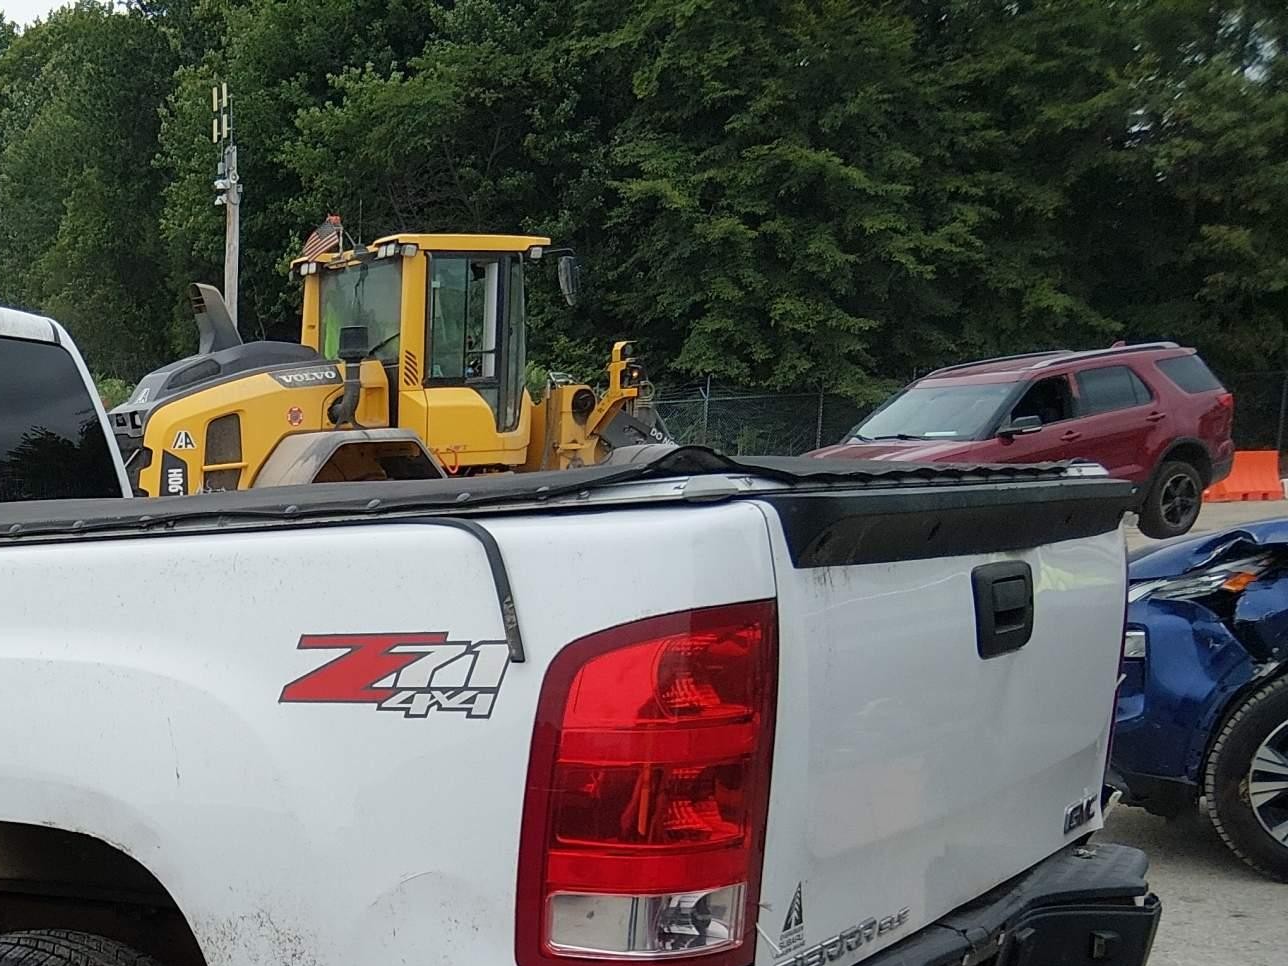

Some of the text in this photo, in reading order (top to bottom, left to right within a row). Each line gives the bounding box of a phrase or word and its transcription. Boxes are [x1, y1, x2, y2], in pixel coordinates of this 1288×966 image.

[279, 370, 337, 383] VOLVO
[167, 468, 184, 497] 90H
[277, 631, 511, 704] Z71
